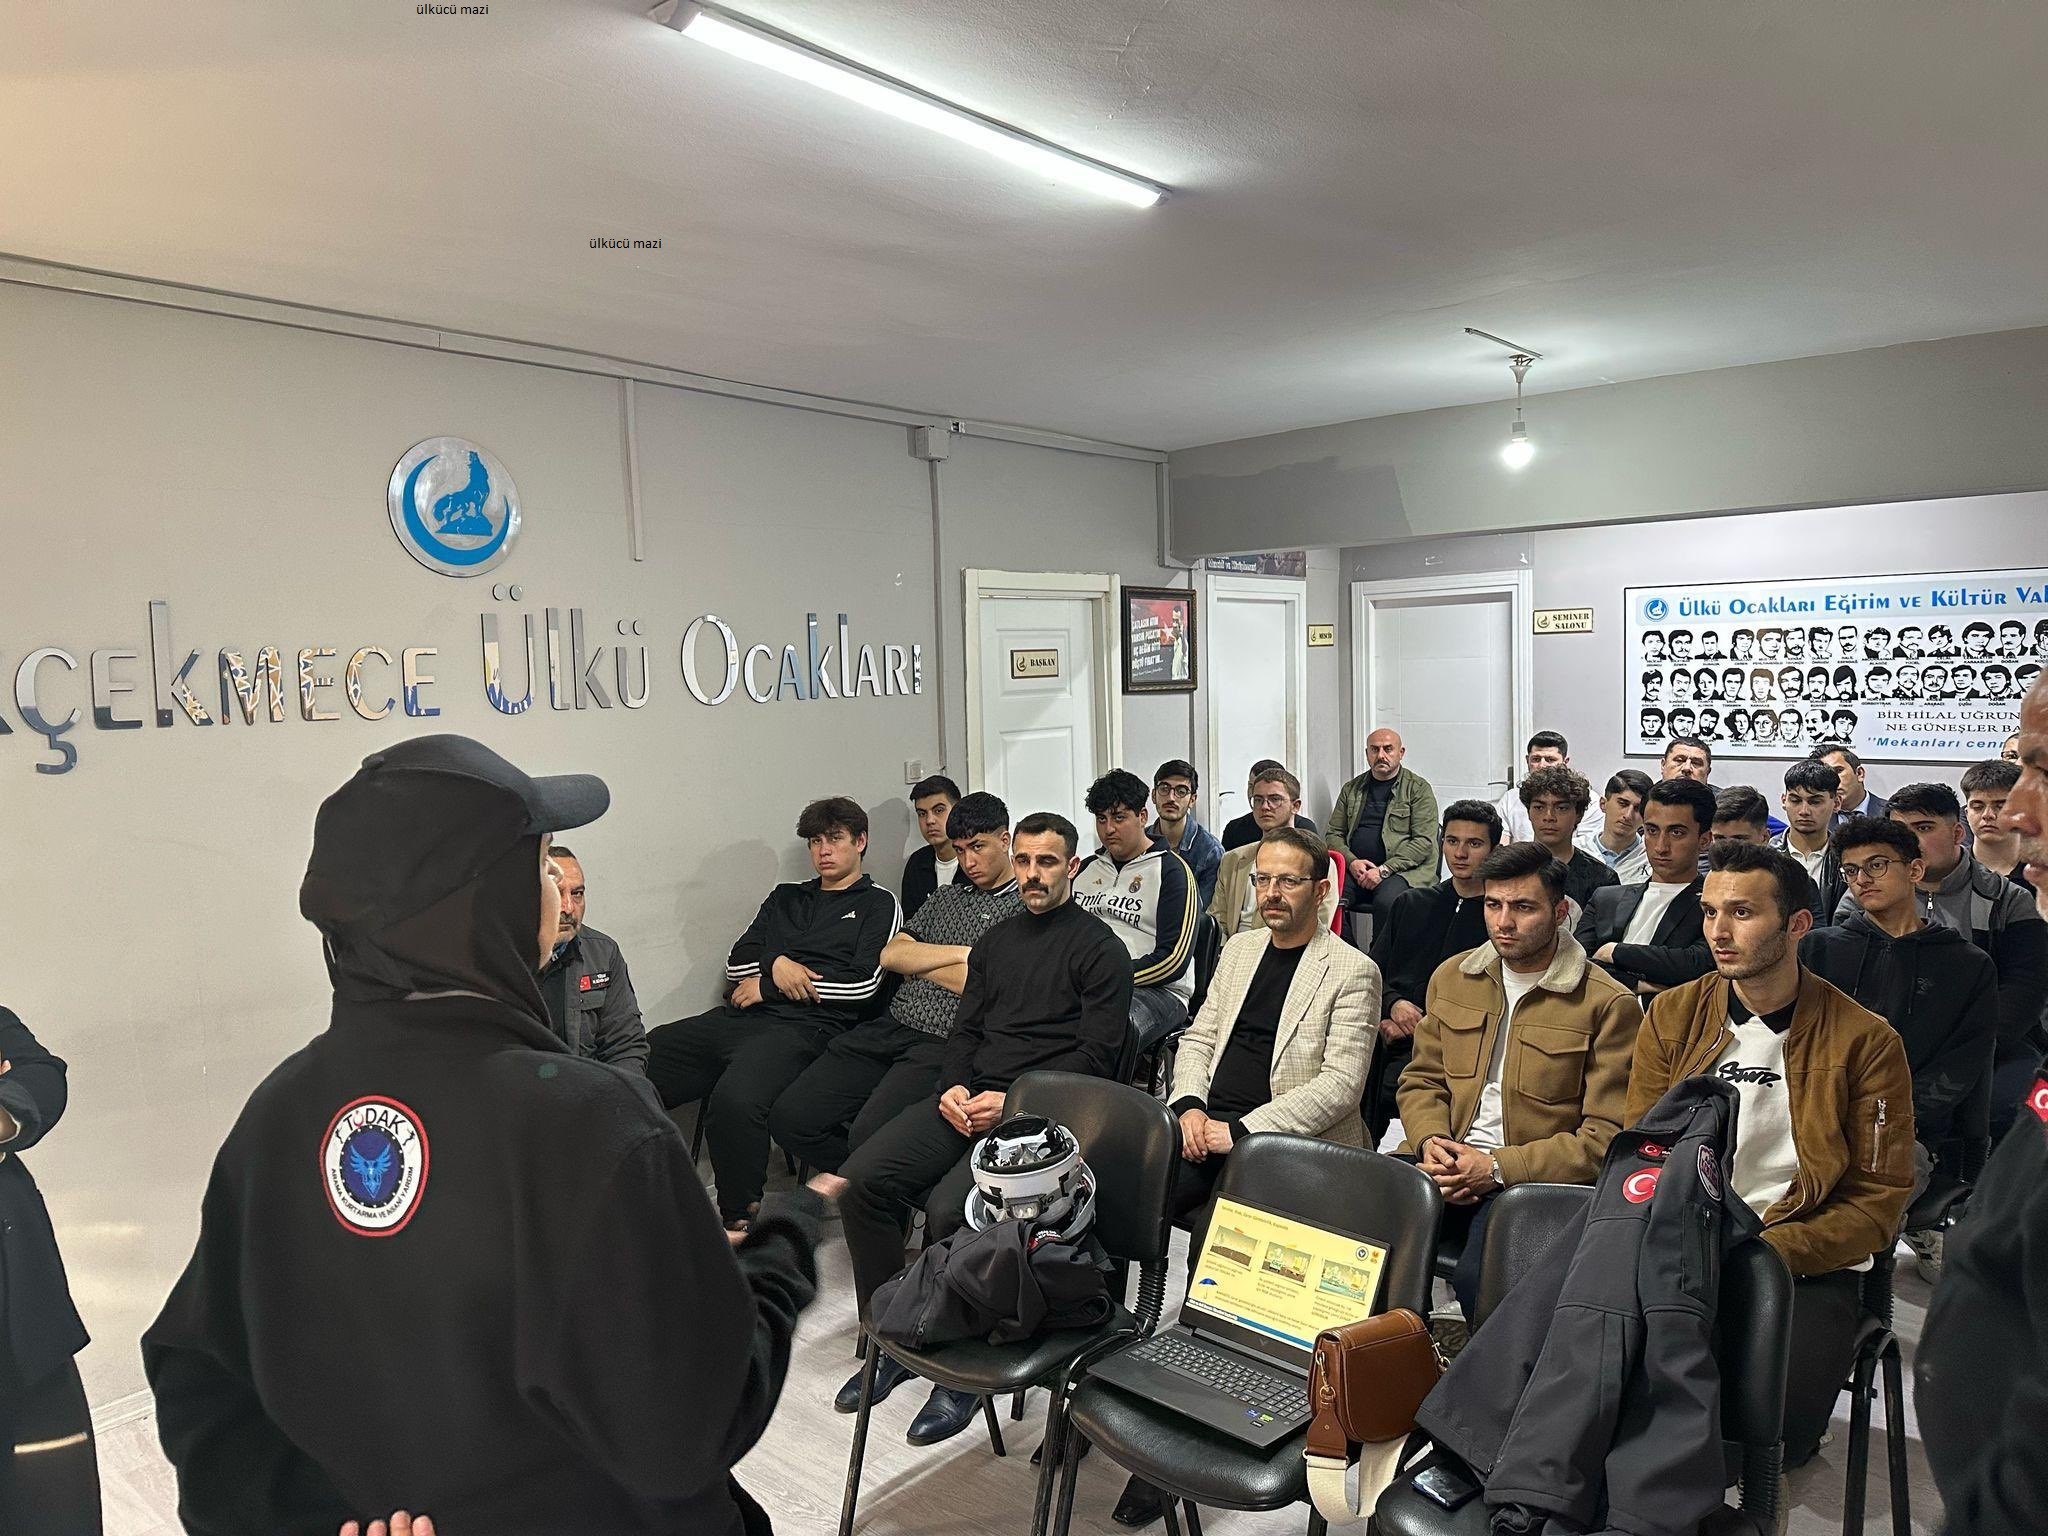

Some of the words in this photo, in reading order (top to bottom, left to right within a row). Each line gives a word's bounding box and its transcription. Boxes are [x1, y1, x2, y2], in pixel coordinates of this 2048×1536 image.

[1554, 621, 1587, 630] SALONU
[0, 599, 441, 775] ÇEKMECE
[1877, 710, 1903, 720] BİR
[1907, 710, 1956, 721] HİLAL
[1886, 724, 1907, 732] NE
[1911, 722, 1998, 734] GÜNEŞLER
[331, 1168, 343, 1197] ARAMA
[341, 1196, 378, 1219] KURTARMA
[378, 1211, 387, 1219] VE
[401, 1166, 414, 1198] YARDIM
